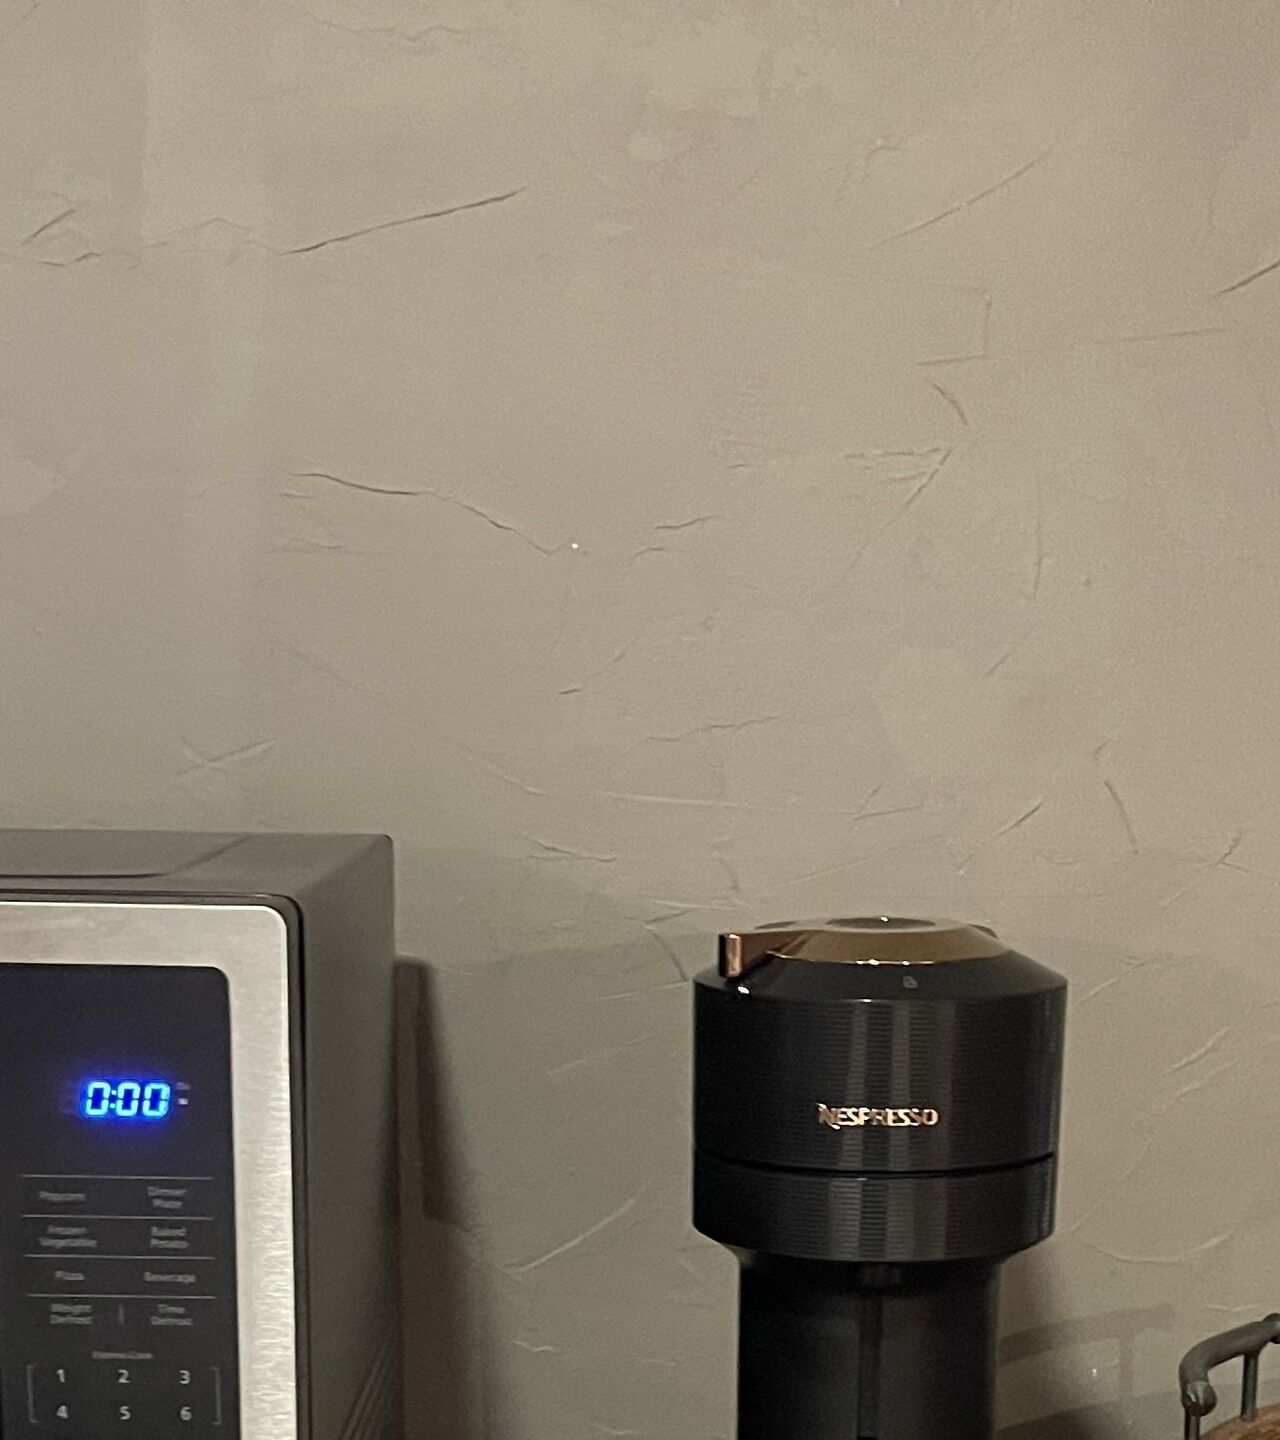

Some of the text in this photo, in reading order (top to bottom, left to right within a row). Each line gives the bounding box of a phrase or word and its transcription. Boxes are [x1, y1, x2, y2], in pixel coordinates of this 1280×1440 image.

[85, 1081, 170, 1117] 0:00
[816, 1103, 939, 1130] NESPRESSO
[56, 1368, 191, 1385] 1 2 3
[56, 1405, 192, 1421] 4 5 6
